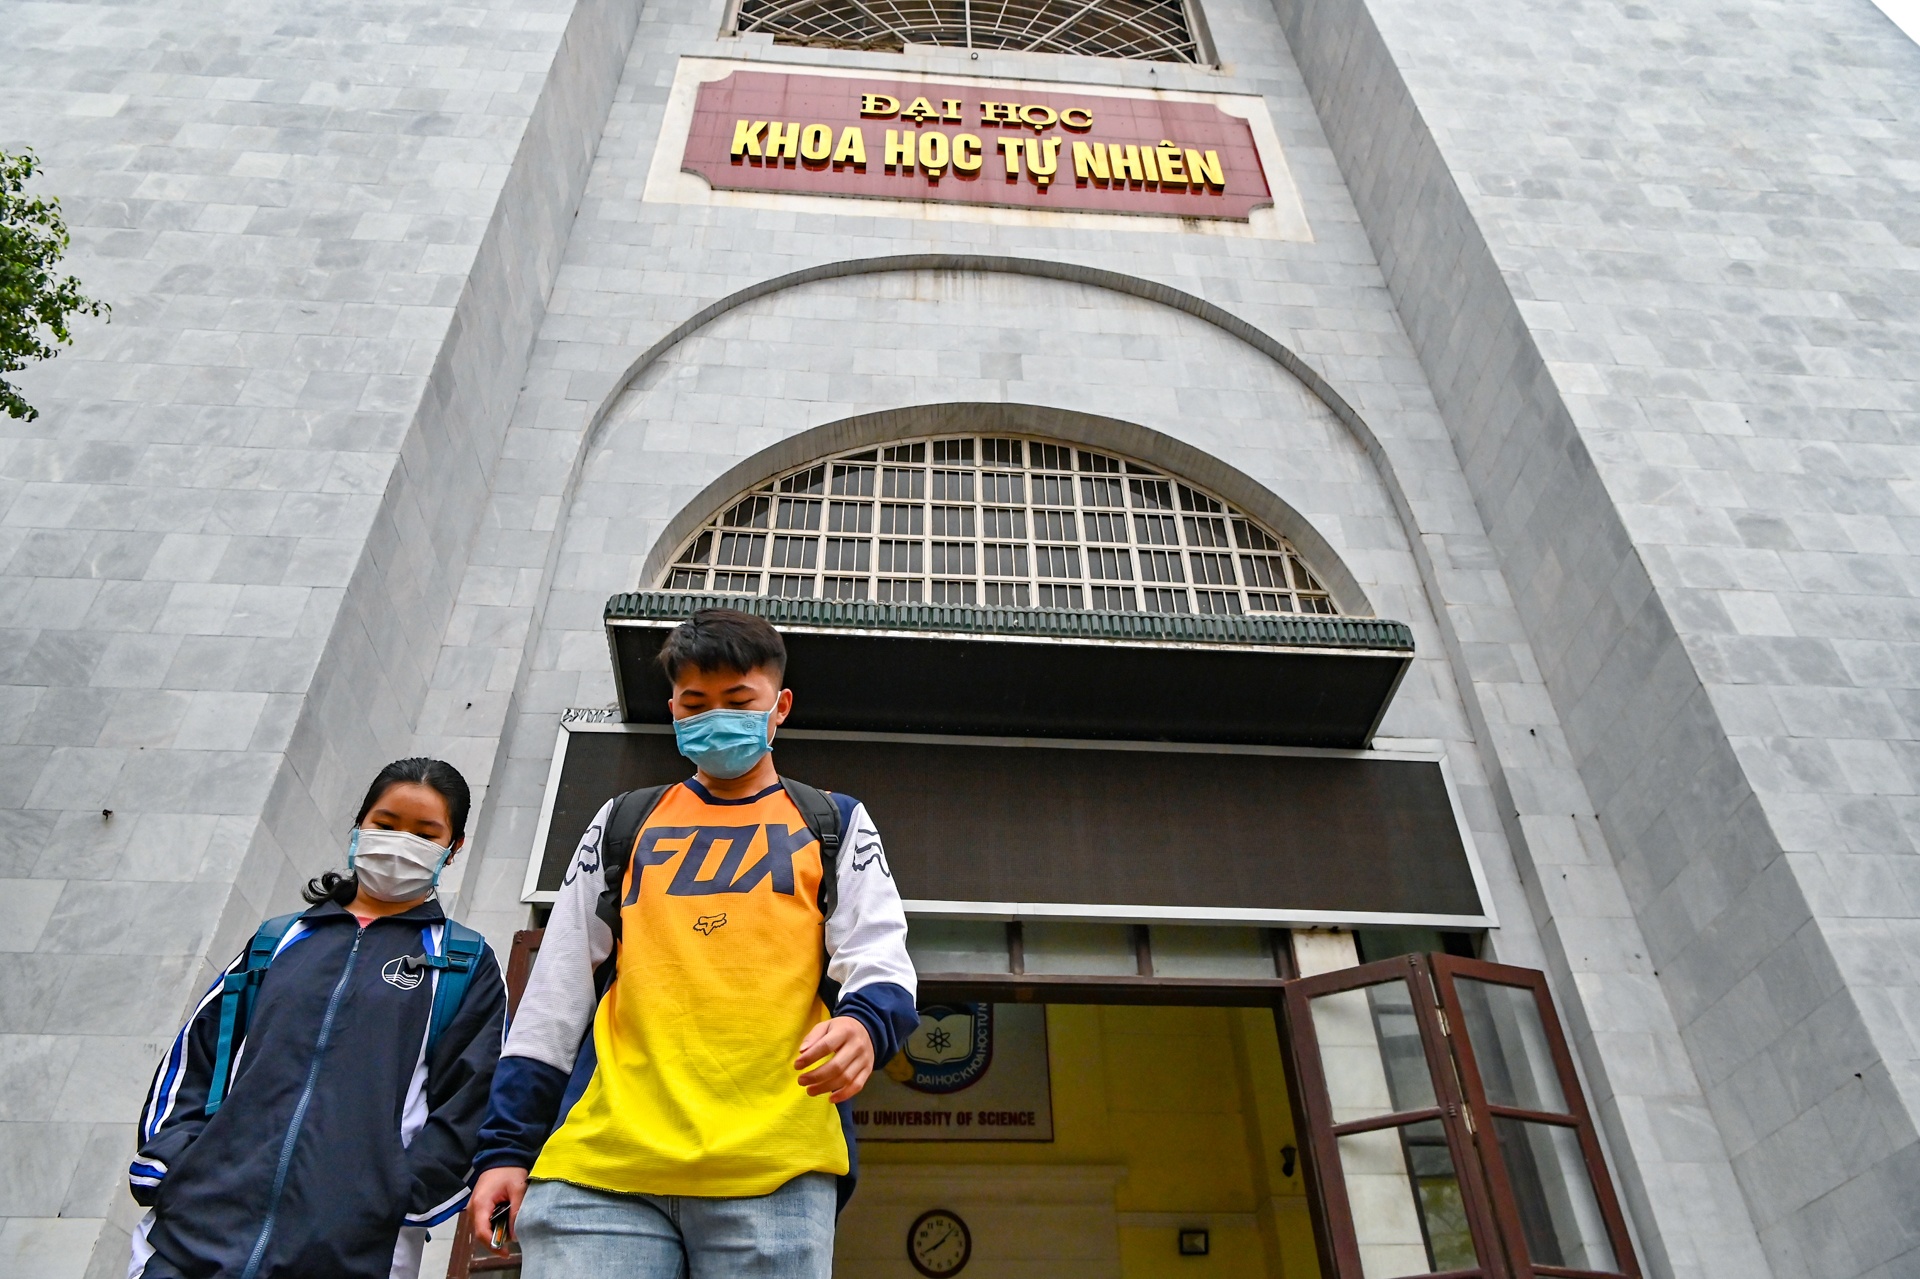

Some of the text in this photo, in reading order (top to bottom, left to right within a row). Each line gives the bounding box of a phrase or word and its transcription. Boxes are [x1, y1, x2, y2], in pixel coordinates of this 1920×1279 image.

[860, 93, 1093, 131] ĐẠI HỌC
[730, 119, 1226, 188] KHOA HỌC TỰ NHIÊN
[622, 824, 819, 907] FOX
[960, 1053, 986, 1079] KHOA
[873, 1111, 952, 1125] UNIVERSITY
[956, 1111, 972, 1125] OF
[977, 1111, 1036, 1126] SCIENCE
